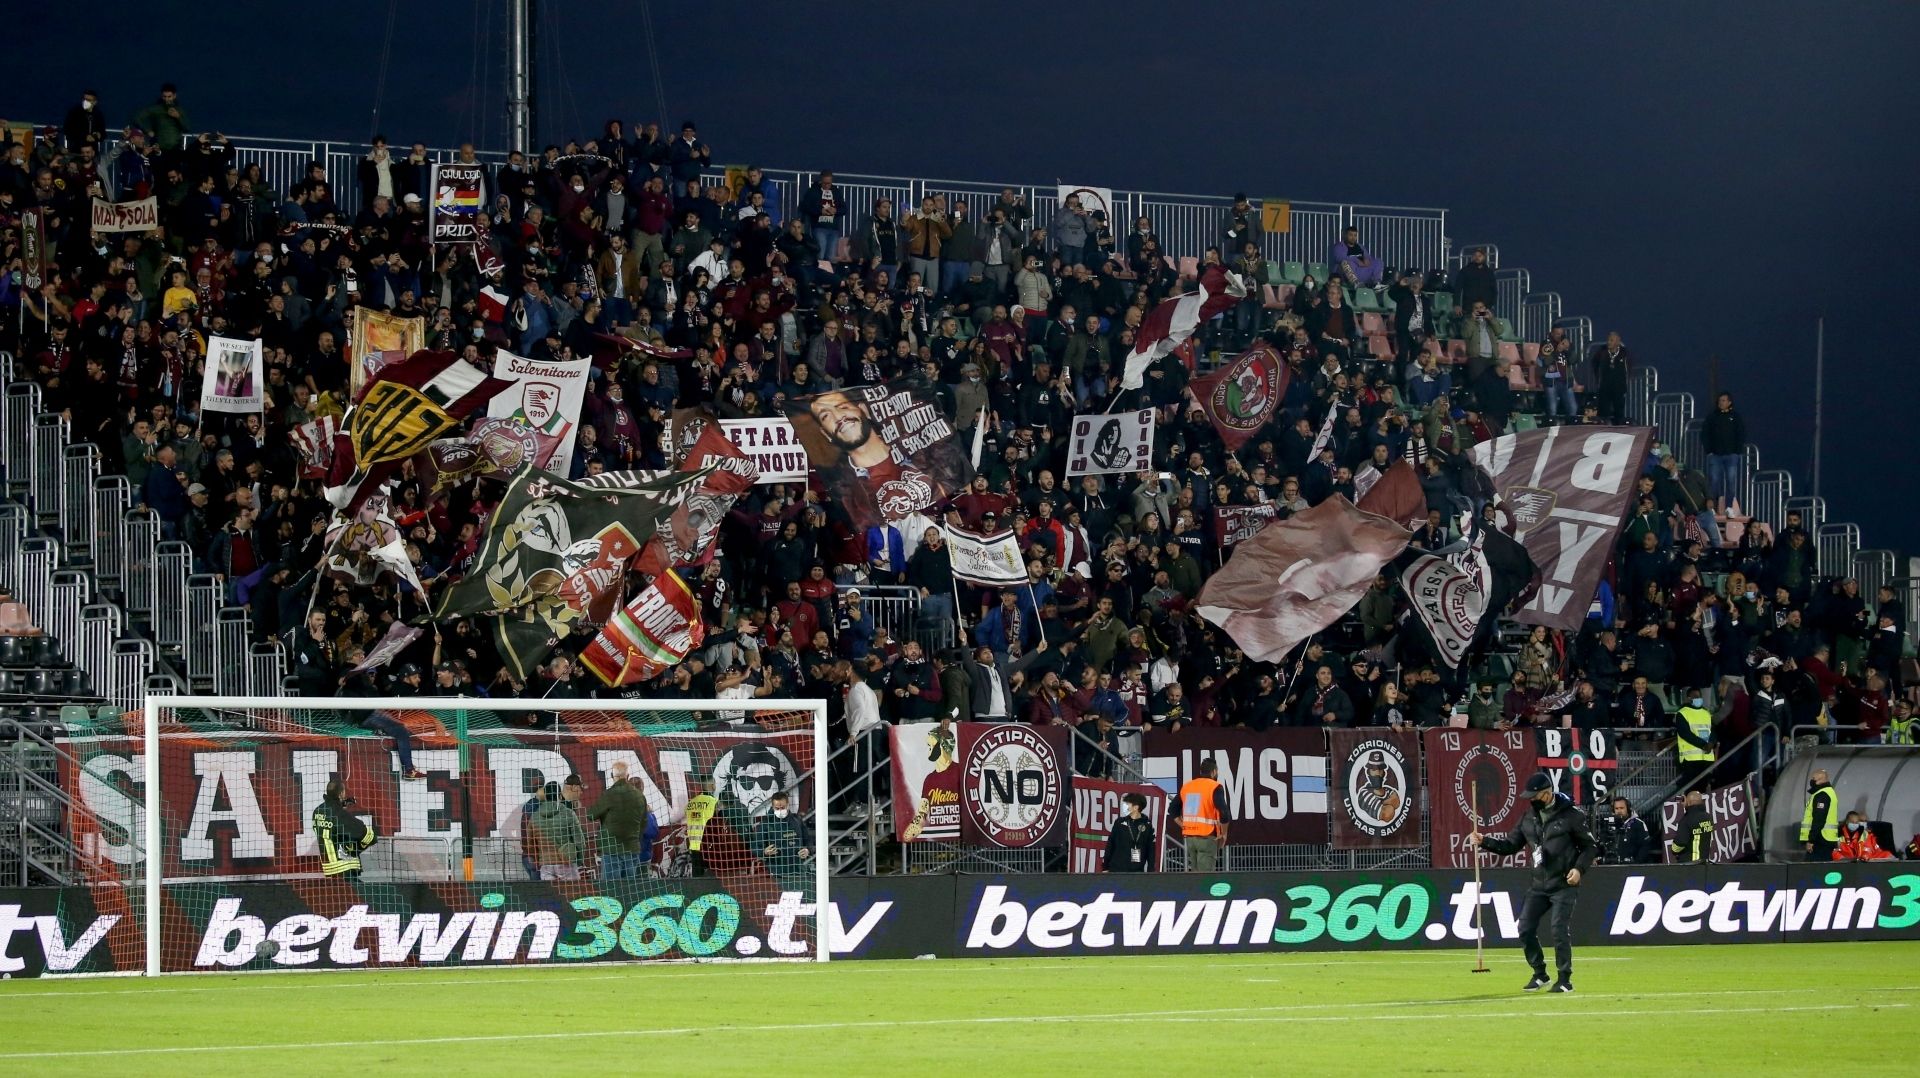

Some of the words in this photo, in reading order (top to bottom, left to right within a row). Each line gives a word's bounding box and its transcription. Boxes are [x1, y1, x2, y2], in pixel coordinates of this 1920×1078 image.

[127, 204, 156, 225] SOLA
[1269, 206, 1281, 230] 7
[508, 358, 581, 378] Salernitana
[529, 409, 545, 418] 1919
[723, 426, 800, 447] ETARA
[881, 419, 900, 444] del
[442, 451, 469, 463] 1919
[746, 452, 805, 473] NQUE
[1348, 740, 1405, 764] TORRIONESI
[928, 787, 959, 805] Matteo
[983, 769, 1044, 805] NO
[930, 805, 960, 815] CENTRO
[930, 814, 960, 825] STORICO
[970, 788, 1001, 837] ALLE
[1343, 797, 1376, 836] ULTRAS
[1380, 796, 1412, 837] SALERNO
[1004, 831, 1026, 841] 1919
[194, 891, 894, 968] betwin360.tv
